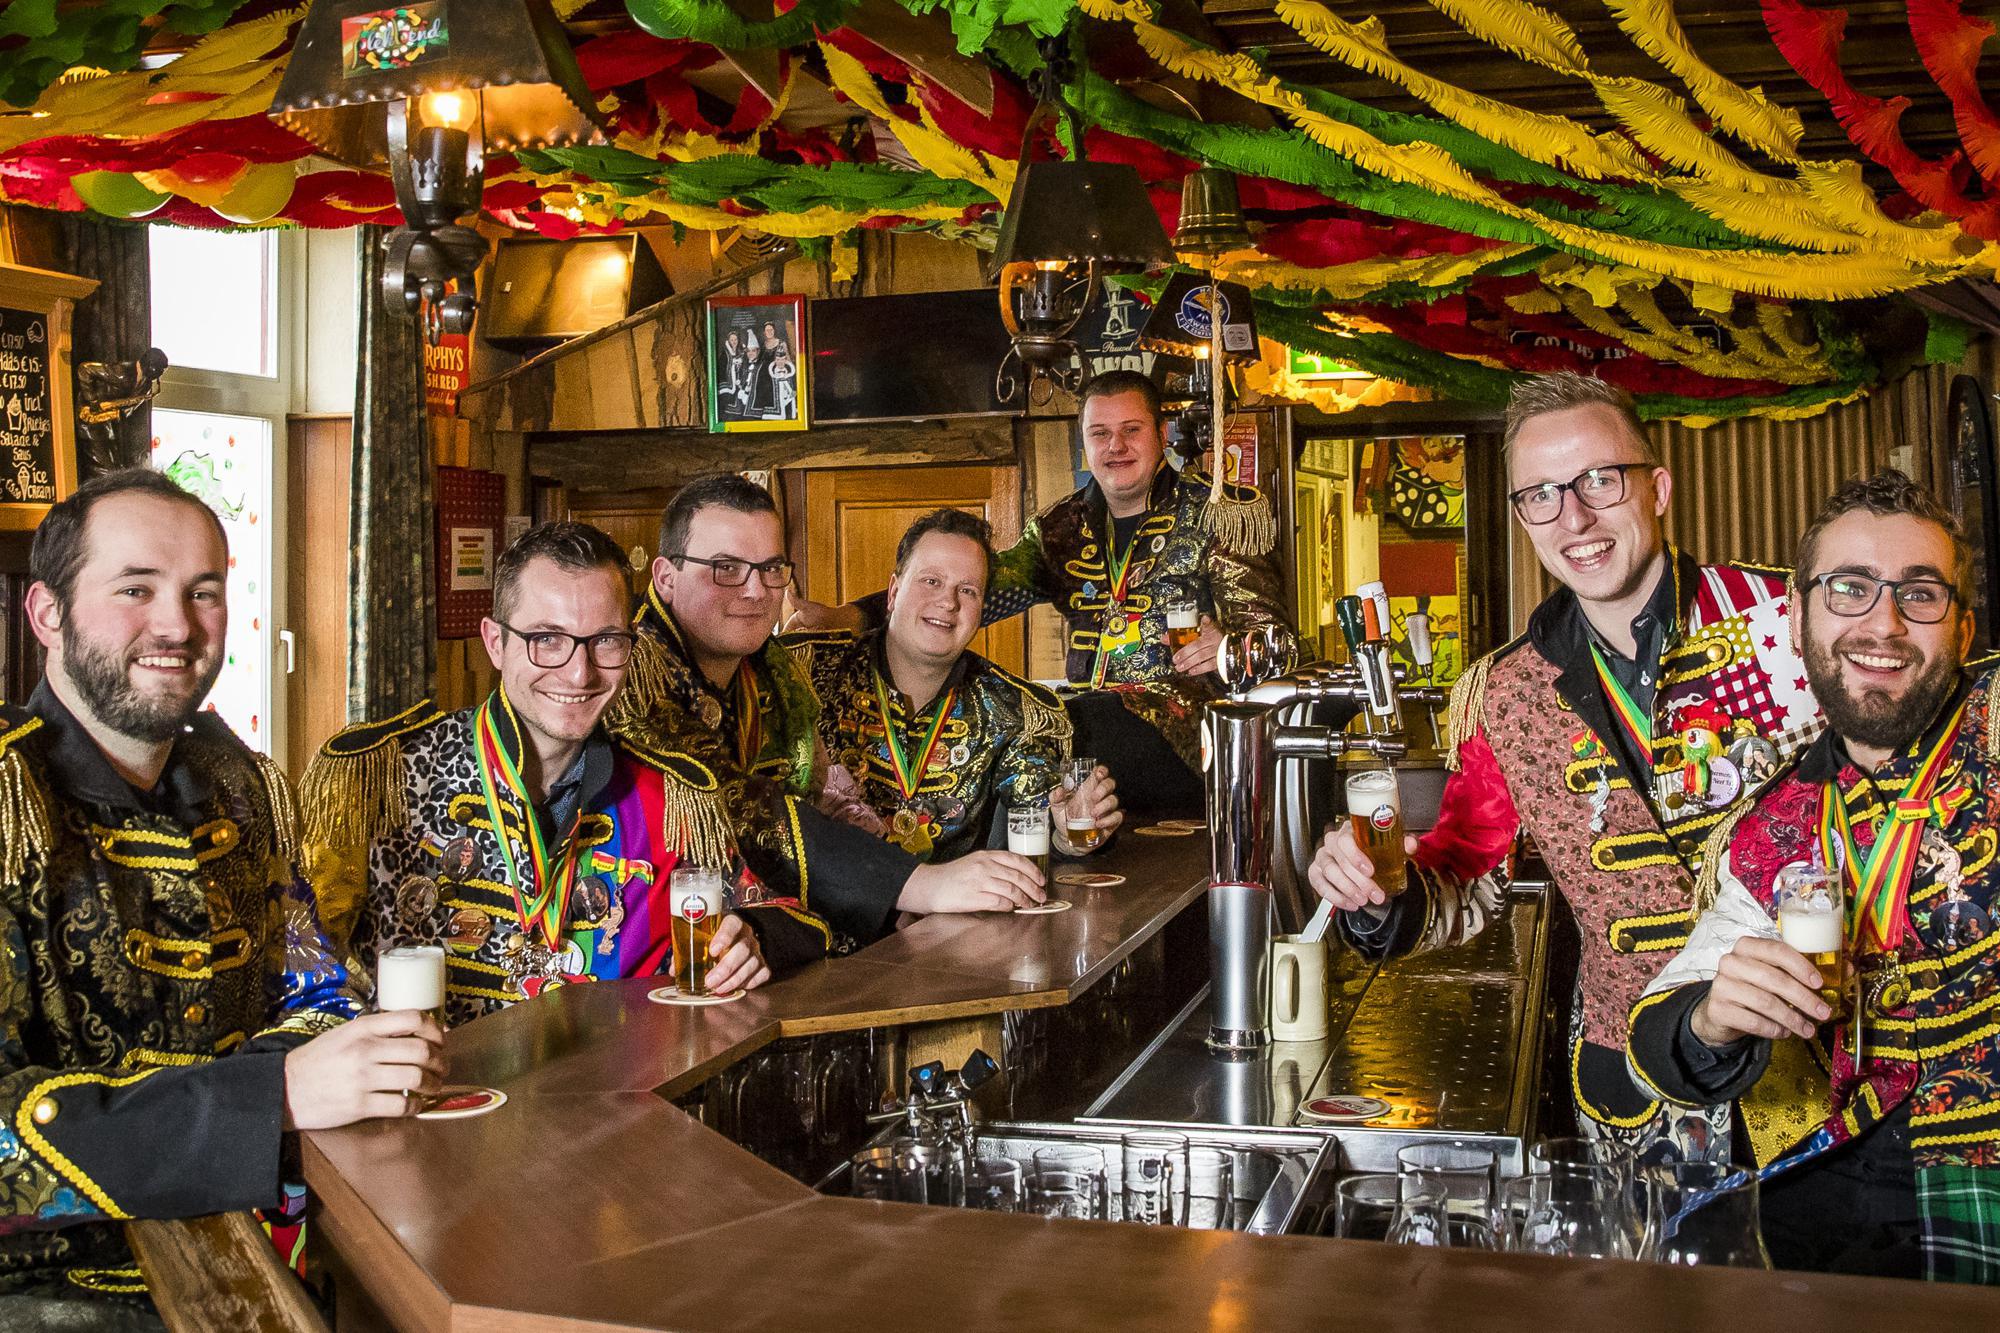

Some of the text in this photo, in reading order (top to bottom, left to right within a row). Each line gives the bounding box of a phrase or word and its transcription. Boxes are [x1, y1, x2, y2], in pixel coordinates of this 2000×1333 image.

[424, 344, 464, 371] RPHY'S
[440, 374, 459, 391] RED
[32, 467, 48, 484] ice
